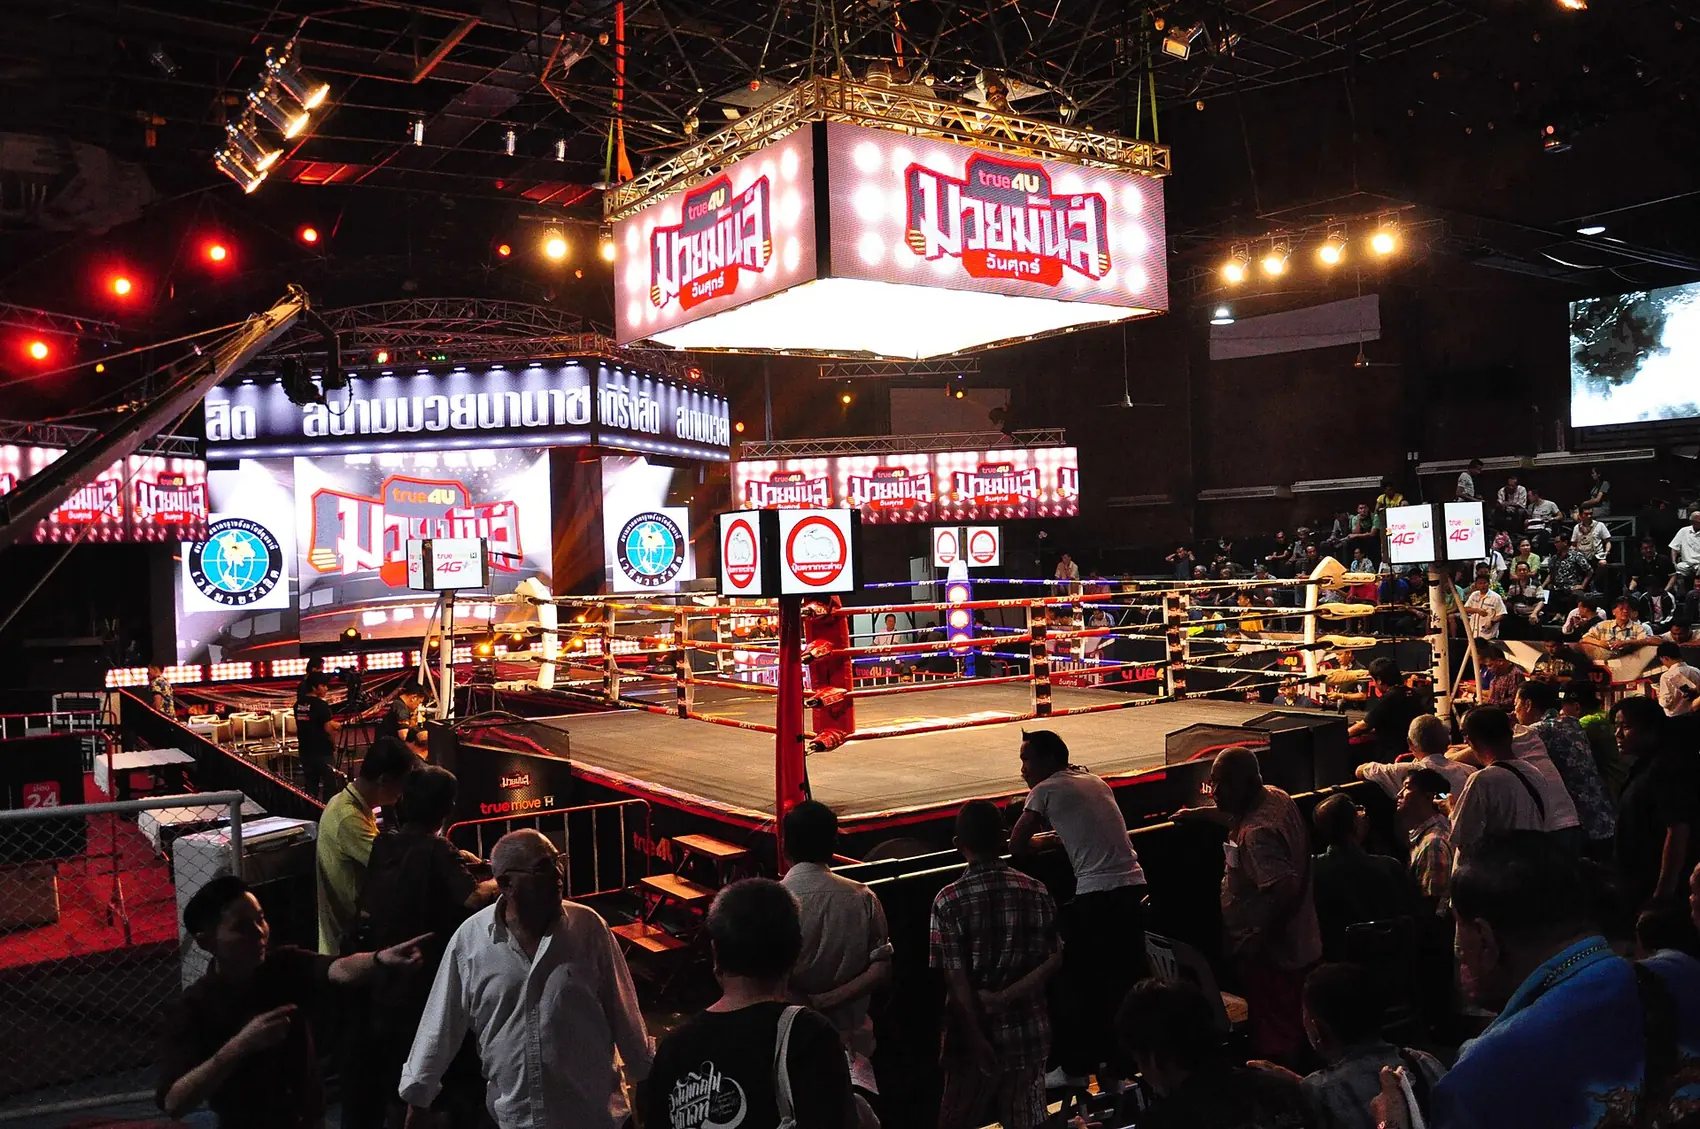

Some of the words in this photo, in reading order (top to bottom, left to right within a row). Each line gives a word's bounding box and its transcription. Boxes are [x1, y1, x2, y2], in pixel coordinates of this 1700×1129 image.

[978, 169, 1040, 193] true4U
[688, 187, 726, 220] true4U
[985, 252, 1041, 276] วันศุกร์
[691, 271, 725, 297] วันศุกร์
[676, 405, 730, 447] สนามมวย
[392, 488, 456, 505] true4U
[26, 790, 60, 809] 24
[480, 798, 542, 815] truemove
